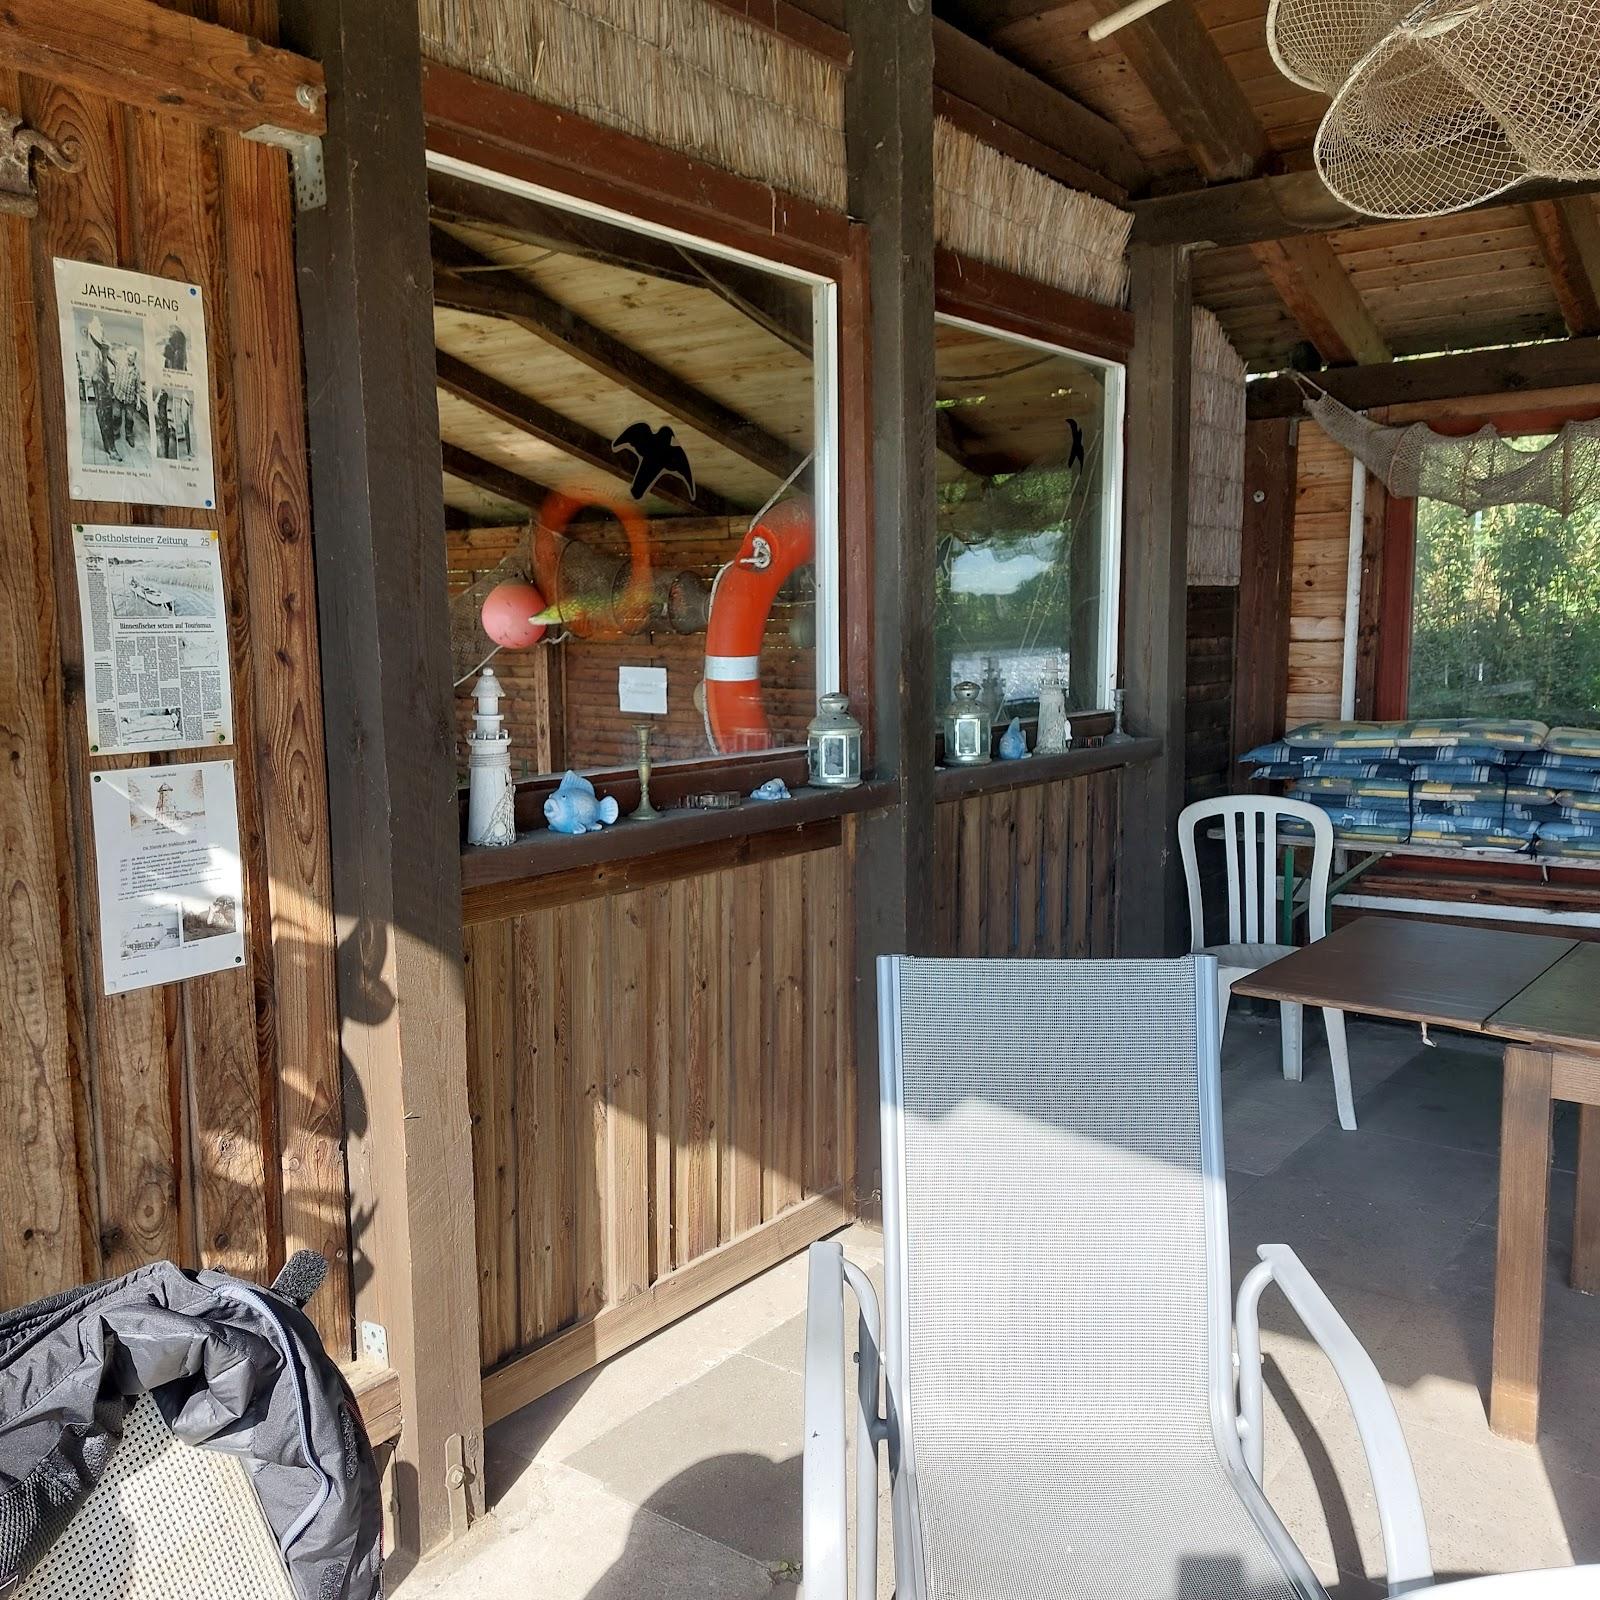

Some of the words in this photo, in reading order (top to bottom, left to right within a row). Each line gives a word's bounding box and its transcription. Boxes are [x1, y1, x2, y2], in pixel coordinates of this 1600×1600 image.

[81, 283, 180, 312] JAHR-100-FANG
[95, 533, 154, 544] Ostholsteiner
[156, 536, 189, 546] Zeitung
[200, 538, 210, 547] 25
